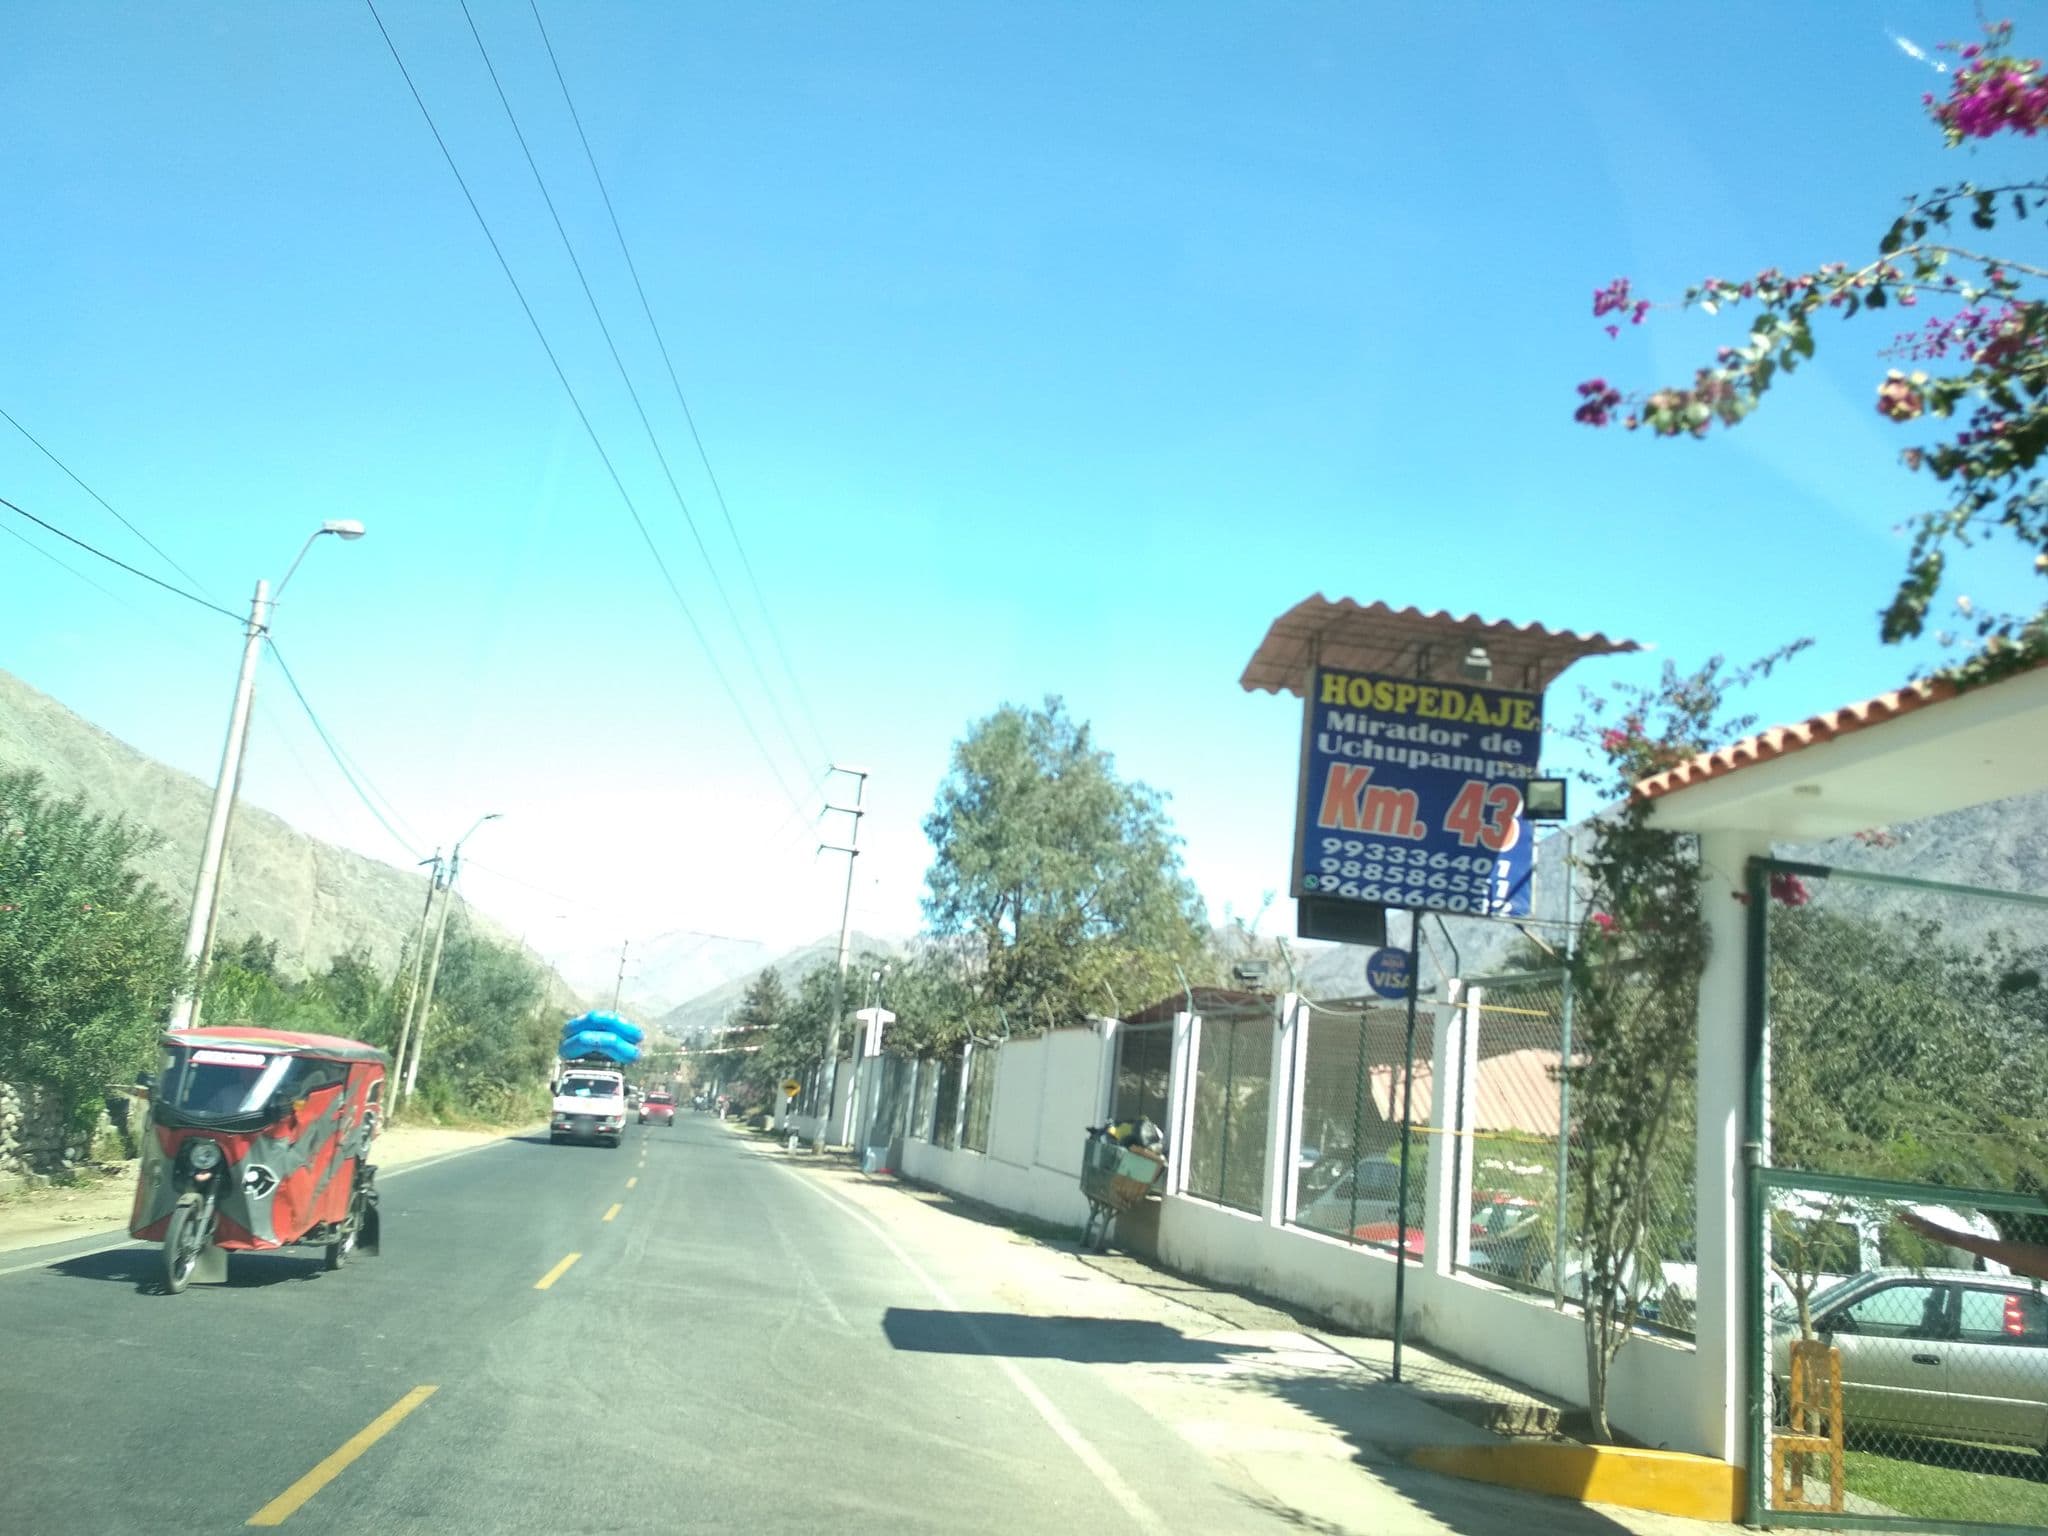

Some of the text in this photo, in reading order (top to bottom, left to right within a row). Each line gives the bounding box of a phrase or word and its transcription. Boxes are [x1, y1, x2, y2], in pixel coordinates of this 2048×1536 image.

[1320, 674, 1535, 731] HOSPEDAJE
[1326, 711, 1523, 755] Mirador de
[1317, 733, 1534, 779] Uchupampa
[1317, 762, 1525, 853] Km. 43
[1320, 857, 1511, 898] 988586551
[1321, 837, 1512, 878] 993336401
[1319, 875, 1513, 917] 966666032
